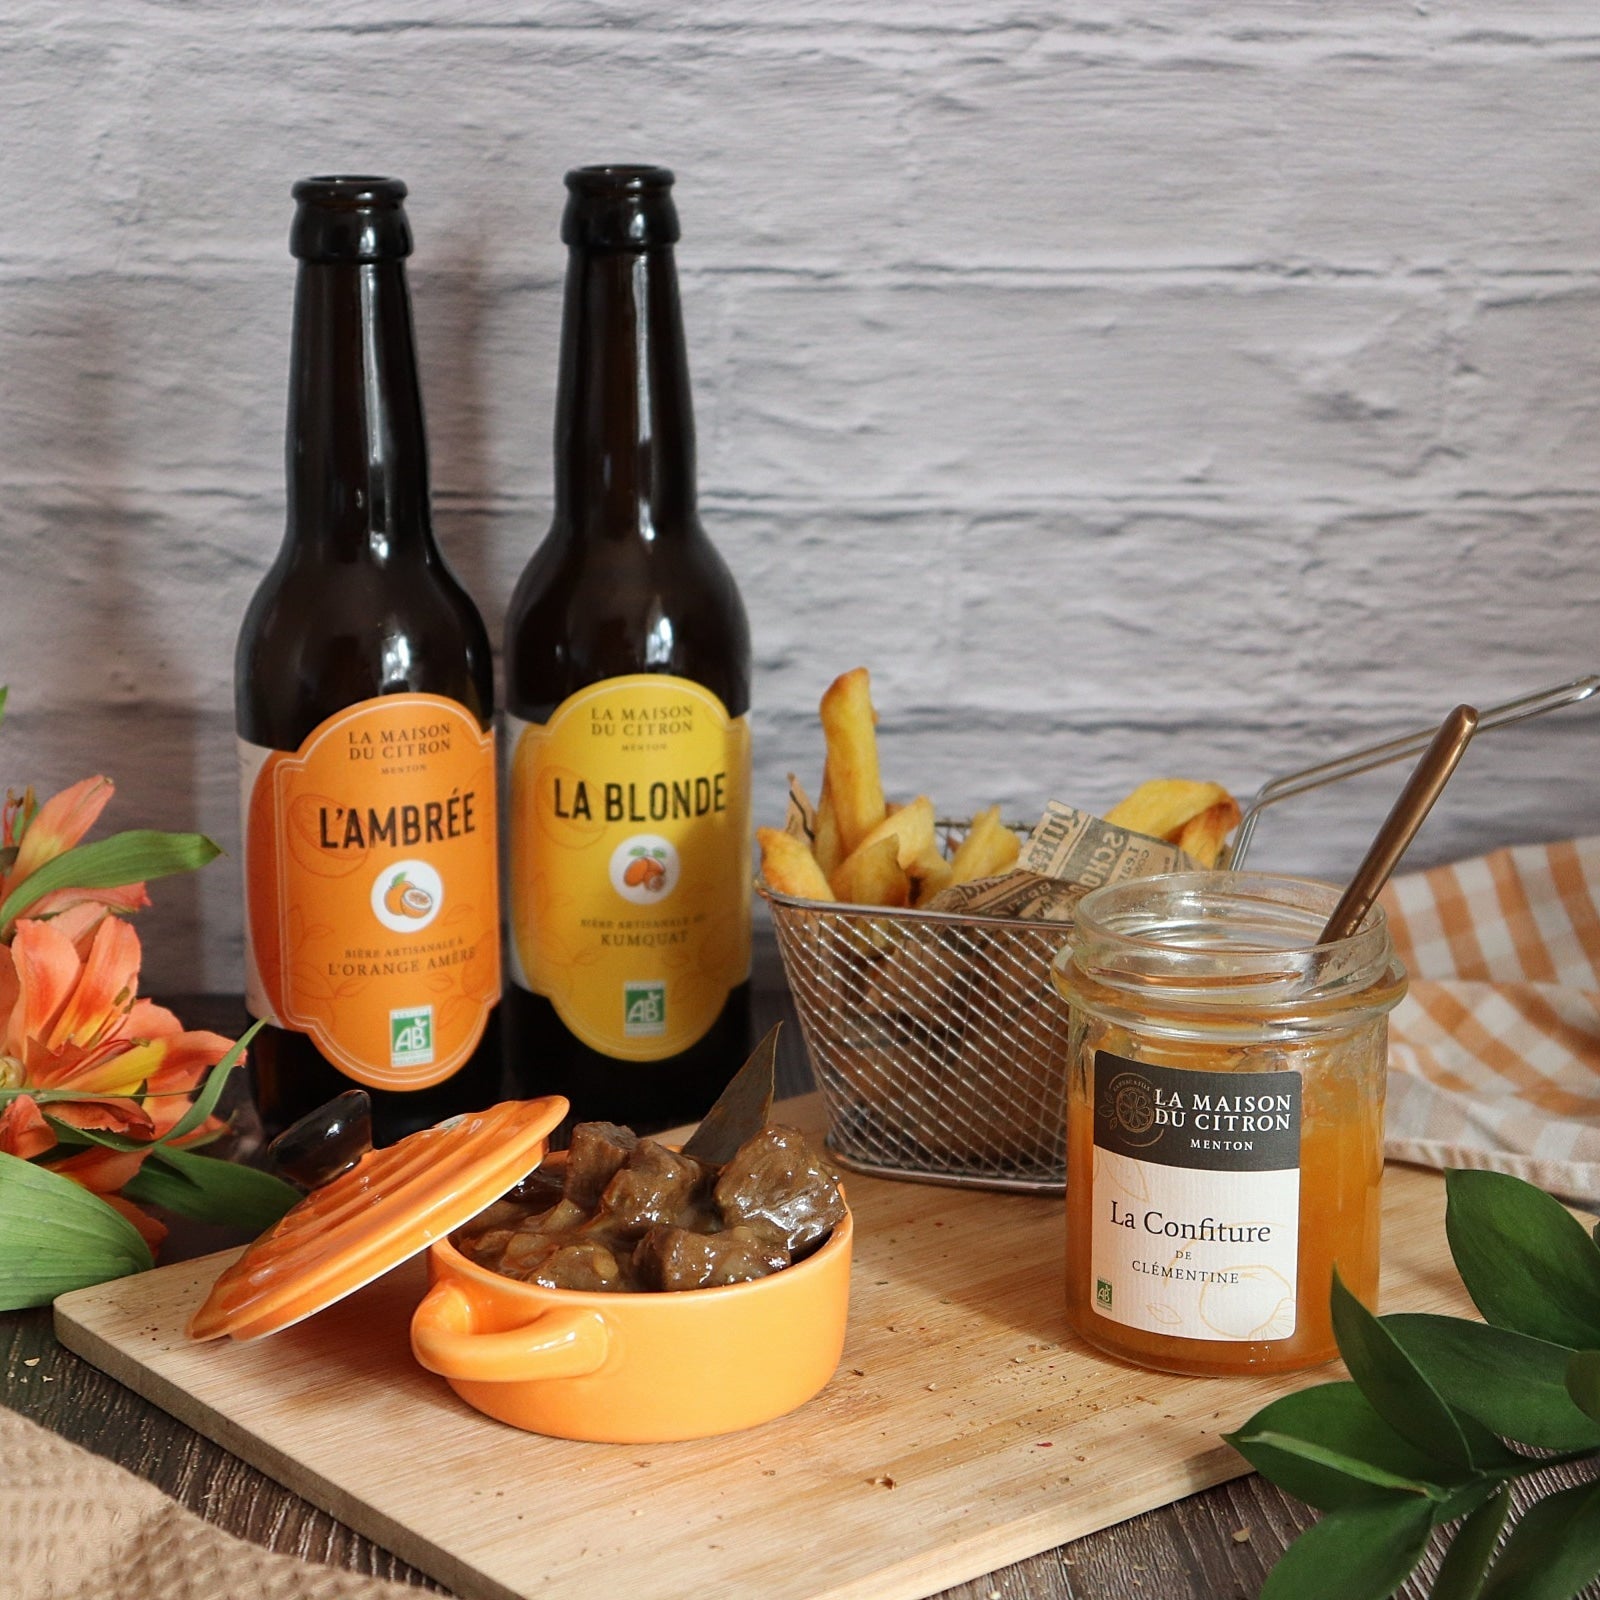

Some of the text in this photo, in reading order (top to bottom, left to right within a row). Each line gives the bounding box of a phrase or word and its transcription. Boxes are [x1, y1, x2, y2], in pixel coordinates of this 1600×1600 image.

[591, 704, 693, 721] LA MAISON
[349, 722, 451, 745] LA MAISON
[591, 720, 694, 737] DU CITRON
[350, 739, 451, 761] DU CITRON
[381, 764, 427, 775] MENTON
[554, 771, 726, 822] LA BLONDE
[384, 940, 455, 958] ARTISANALE
[601, 931, 689, 948] KUMQUAT
[627, 999, 660, 1024] AB
[394, 1026, 427, 1051] AB
[1154, 1088, 1292, 1113] LA MAISON
[1154, 1108, 1291, 1132] DU CITRON
[1190, 1139, 1253, 1151] MENTON
[1110, 1200, 1271, 1243] La Confiture
[1175, 1250, 1193, 1261] DE
[1132, 1260, 1239, 1284] CLÉMENTINE
